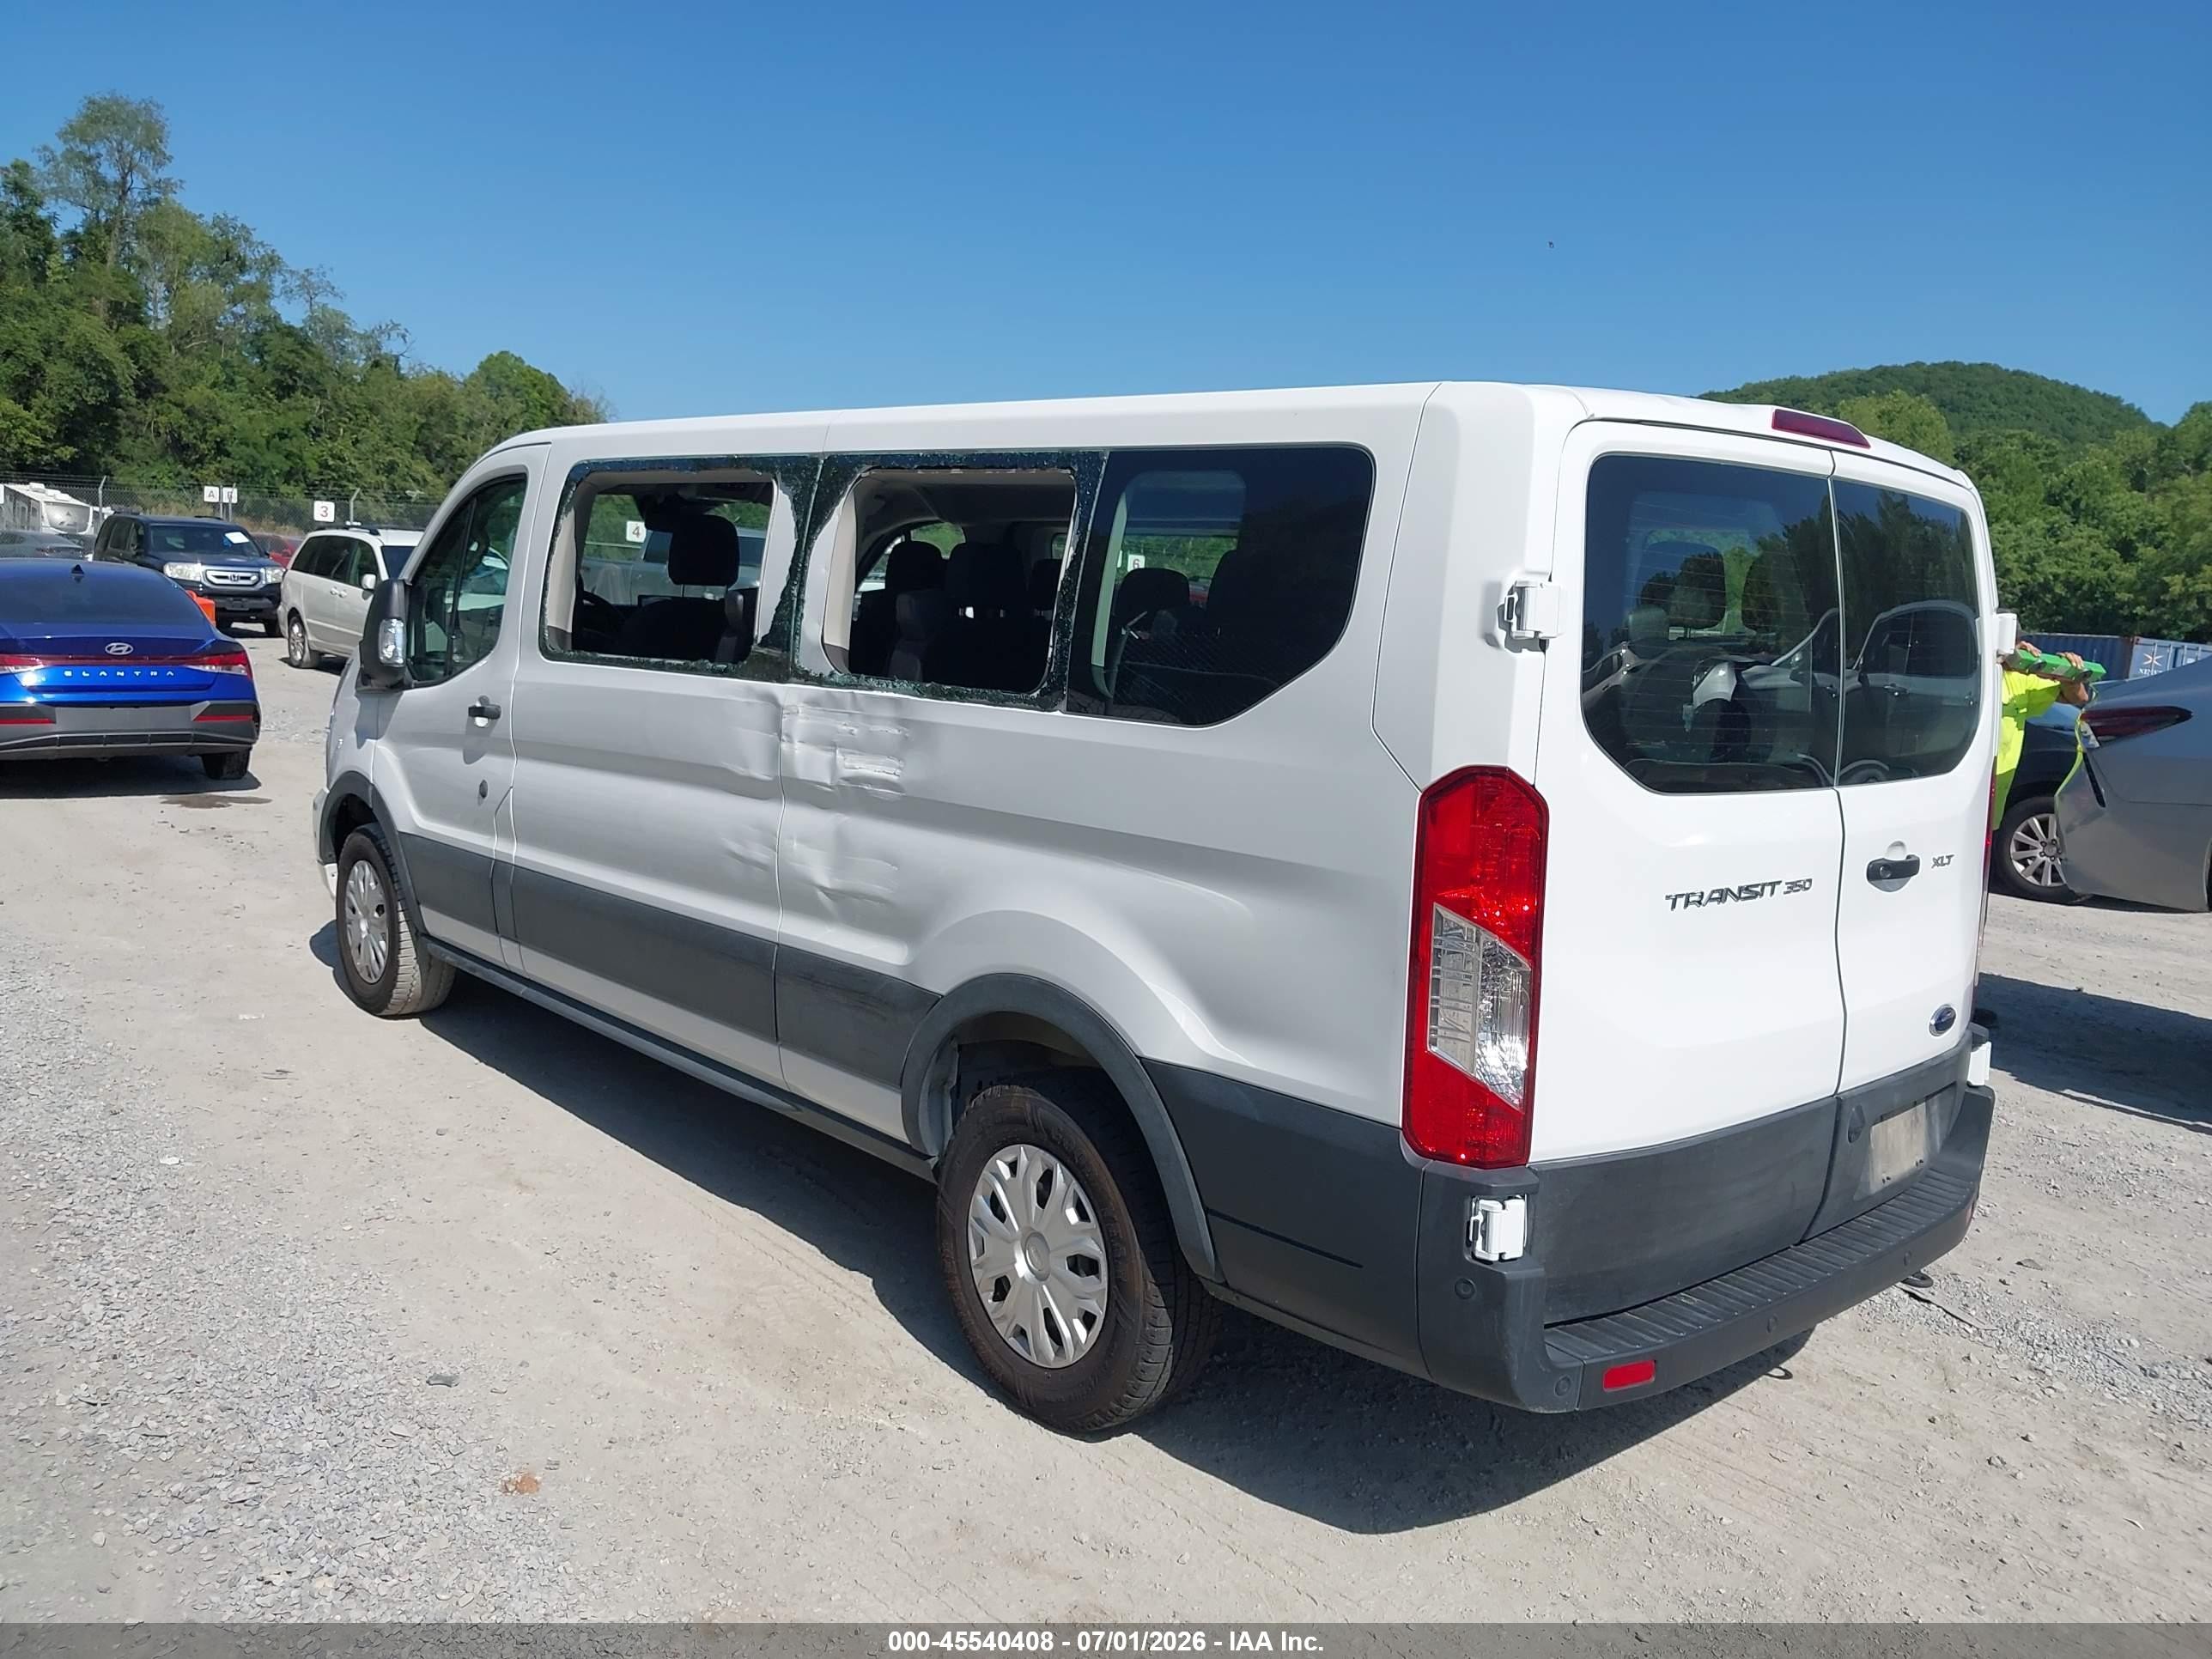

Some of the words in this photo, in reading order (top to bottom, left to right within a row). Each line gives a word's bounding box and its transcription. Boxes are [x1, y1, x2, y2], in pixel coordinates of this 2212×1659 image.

[319, 506, 329, 518] 3
[632, 526, 641, 538] 4
[1133, 558, 1140, 568] 6
[1931, 854, 1955, 869] XLT
[1665, 880, 1783, 912] TRANSIT
[1784, 878, 1813, 895] 350
